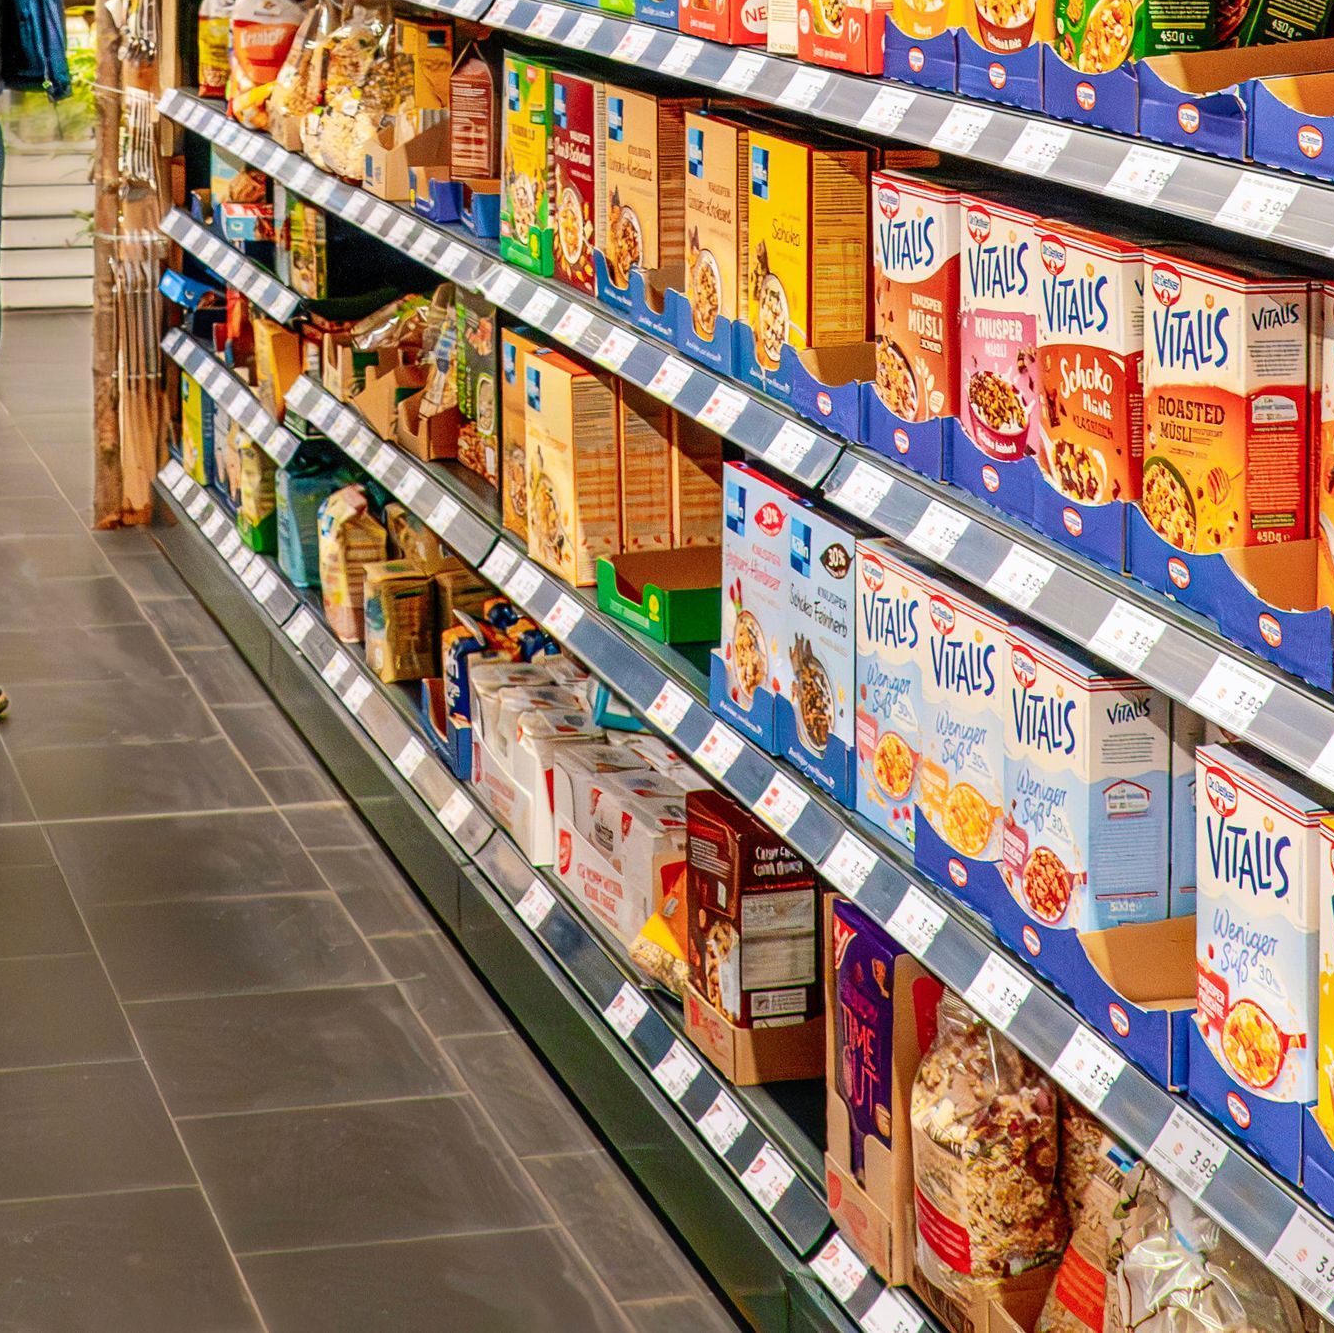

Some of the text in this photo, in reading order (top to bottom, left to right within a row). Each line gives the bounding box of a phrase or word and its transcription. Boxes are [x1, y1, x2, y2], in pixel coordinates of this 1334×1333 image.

[1263, 197, 1289, 218] 3.99
[907, 311, 944, 338] MÜSLI
[973, 313, 1024, 343] KNUSPER
[1059, 351, 1115, 403] Schoko
[1156, 393, 1226, 425] ROASTED
[1159, 417, 1193, 441] MÜSLI
[827, 548, 846, 568] 30%
[1020, 571, 1045, 594] 3.99
[1129, 631, 1155, 654] 3.99
[1233, 691, 1263, 715] 3.99
[935, 710, 988, 753] Weniger
[1213, 907, 1277, 957] Weniger
[1219, 941, 1250, 985] Süß
[999, 986, 1023, 1009] 3.99
[1090, 1056, 1119, 1090] 3.99
[1188, 1143, 1217, 1180] 3.99
